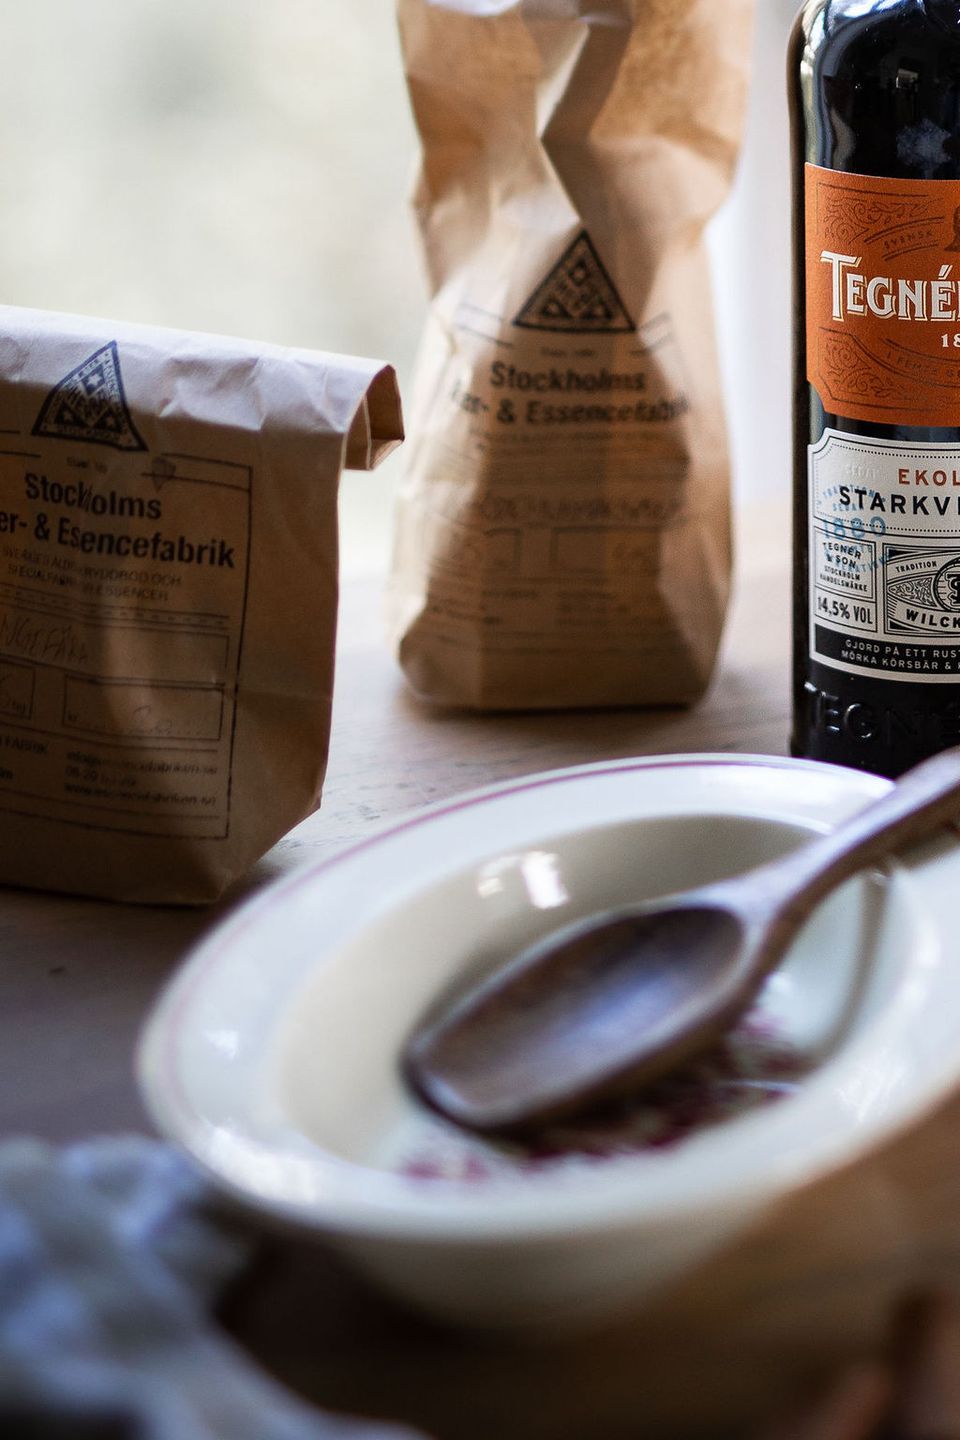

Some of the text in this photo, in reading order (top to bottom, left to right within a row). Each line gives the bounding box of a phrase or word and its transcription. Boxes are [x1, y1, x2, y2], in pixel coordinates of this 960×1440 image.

[490, 360, 647, 392] Stockholms
[33, 511, 51, 542] &
[821, 515, 887, 541] 1880
[835, 554, 857, 569] SON
[895, 560, 938, 573] TRADITION
[816, 596, 874, 625] 14,5% VOL
[845, 638, 880, 654] GJORD
[885, 646, 900, 656] PÅ
[905, 648, 927, 657] ETT
[841, 649, 878, 665] MÖRKA
[882, 657, 938, 670] KÖRSBÄR
[944, 661, 952, 670] &
